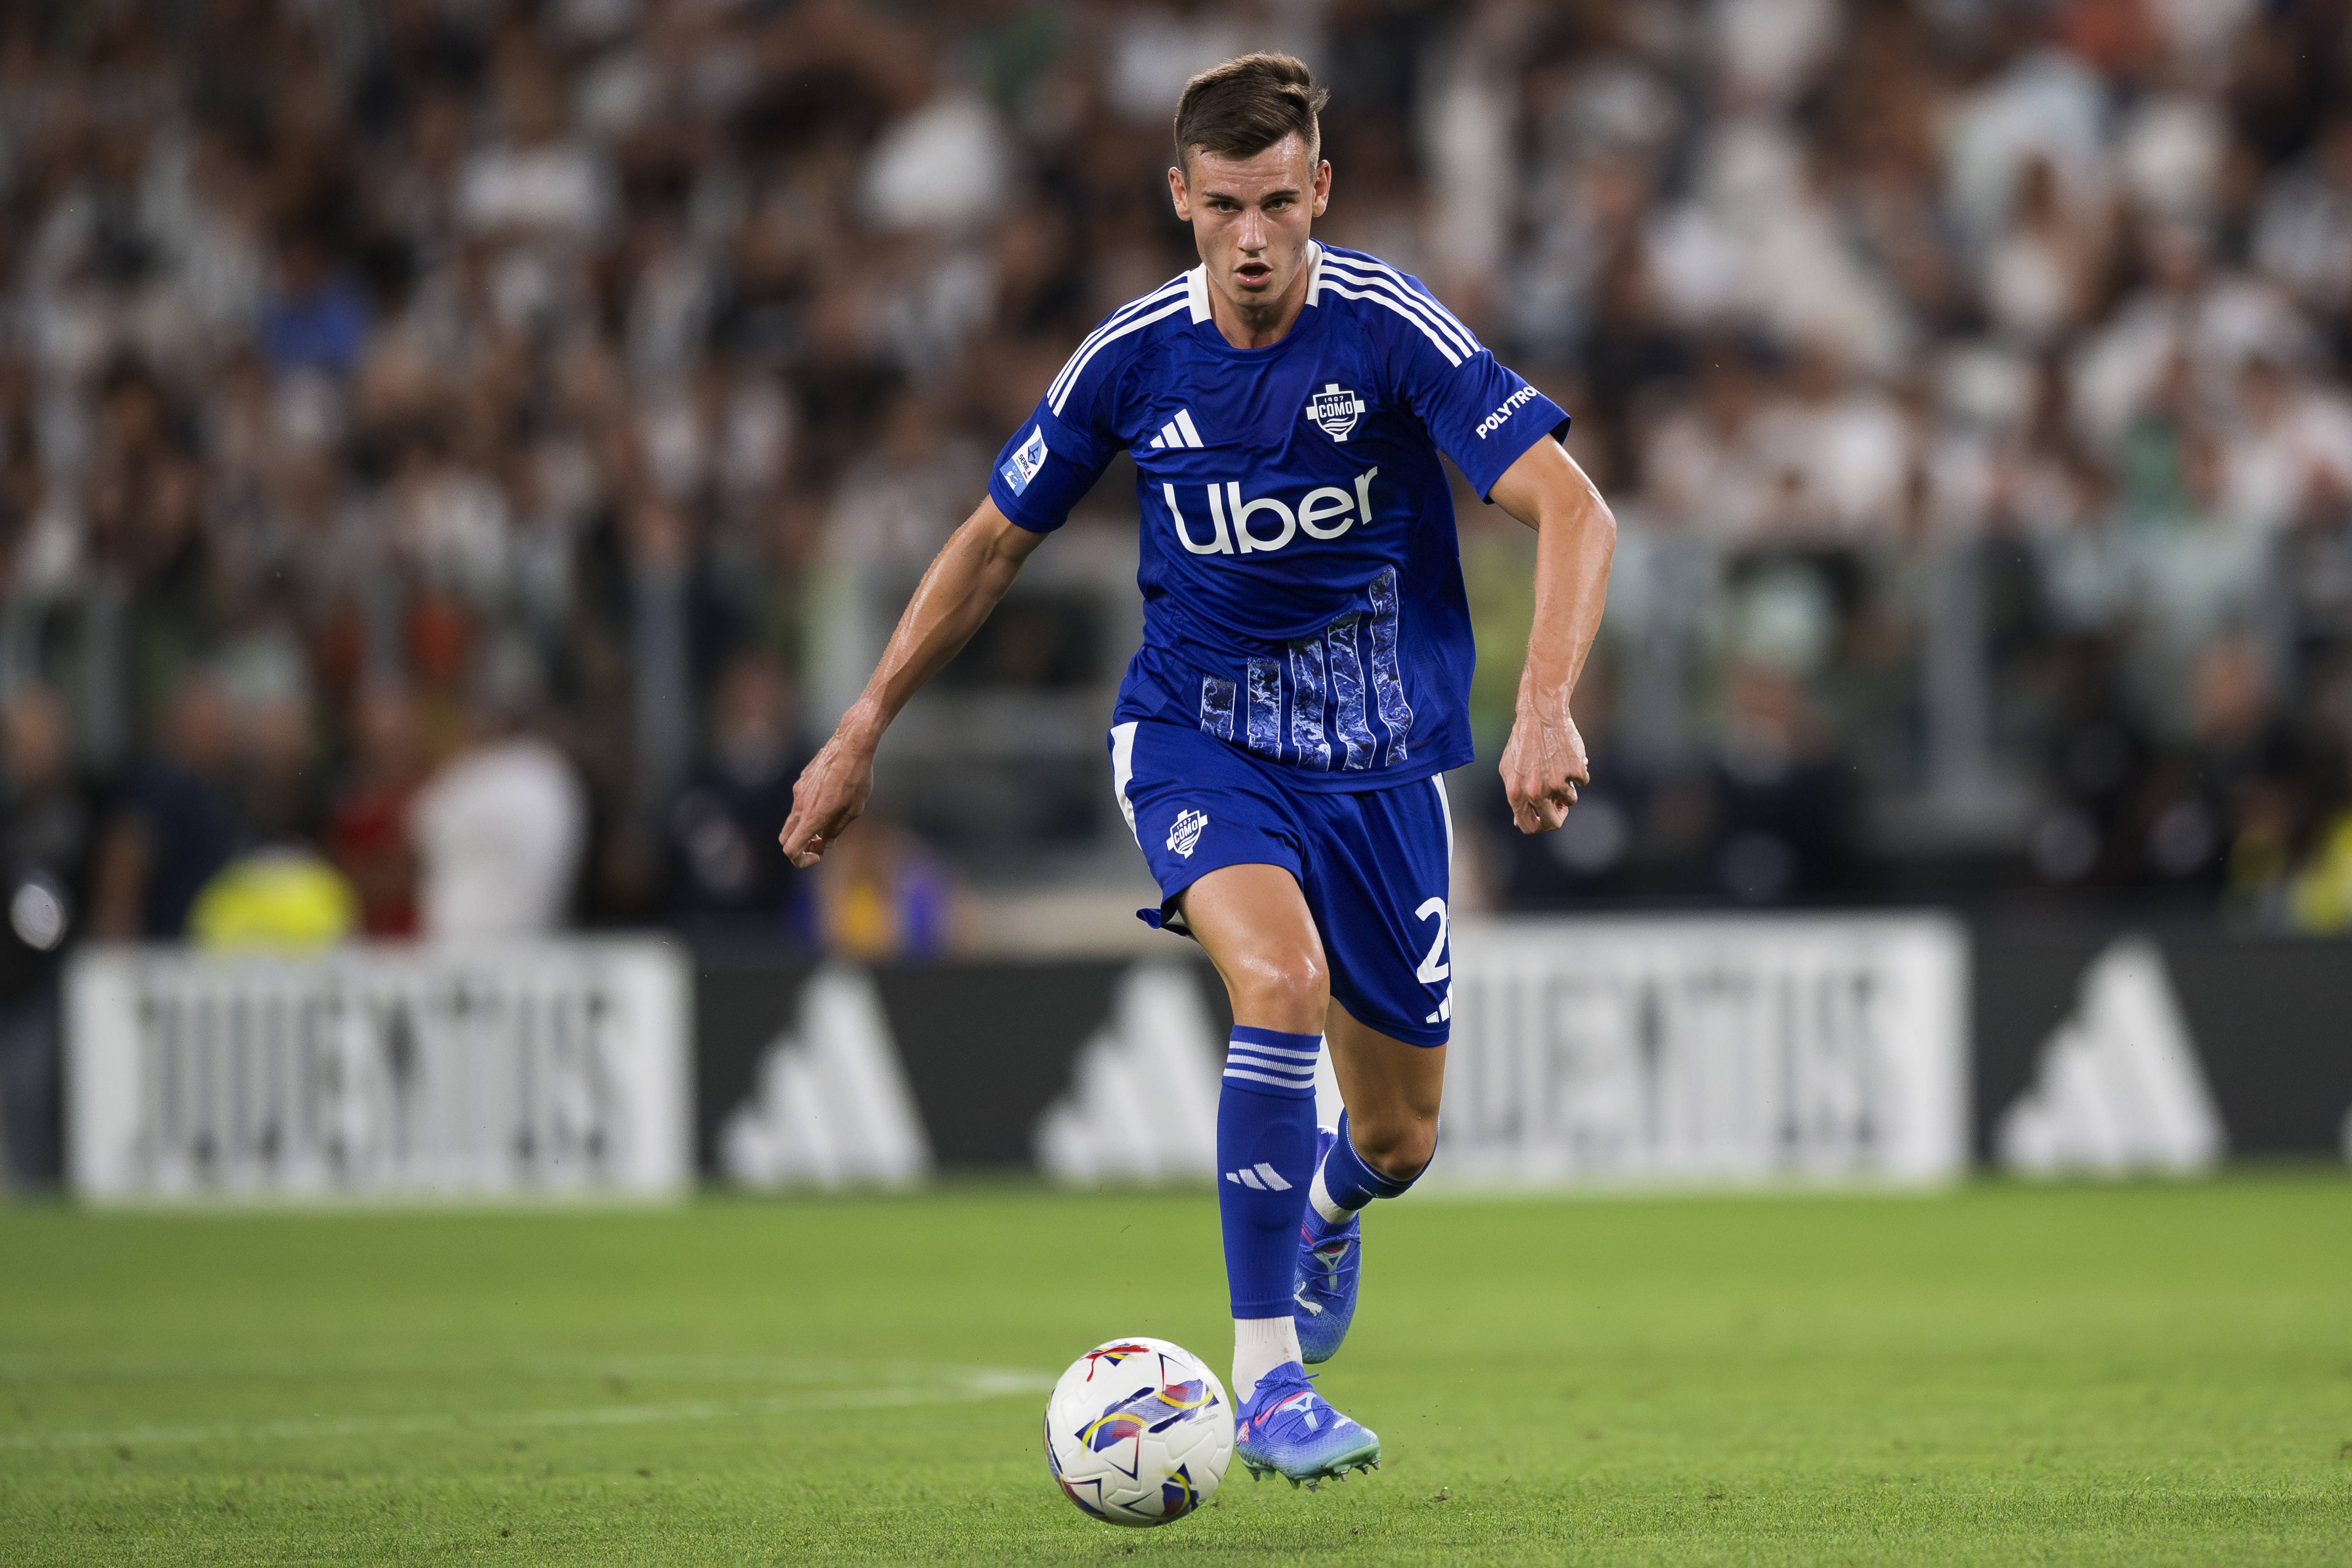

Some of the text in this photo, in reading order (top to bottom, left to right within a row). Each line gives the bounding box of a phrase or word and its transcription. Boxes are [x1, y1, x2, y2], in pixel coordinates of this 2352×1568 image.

[1318, 401, 1354, 418] COMO
[1324, 395, 1344, 403] 1907
[1018, 454, 1030, 471] SERIE
[1162, 466, 1378, 554] Uber
[1174, 819, 1198, 844] COMO
[1415, 897, 1451, 984] 2
